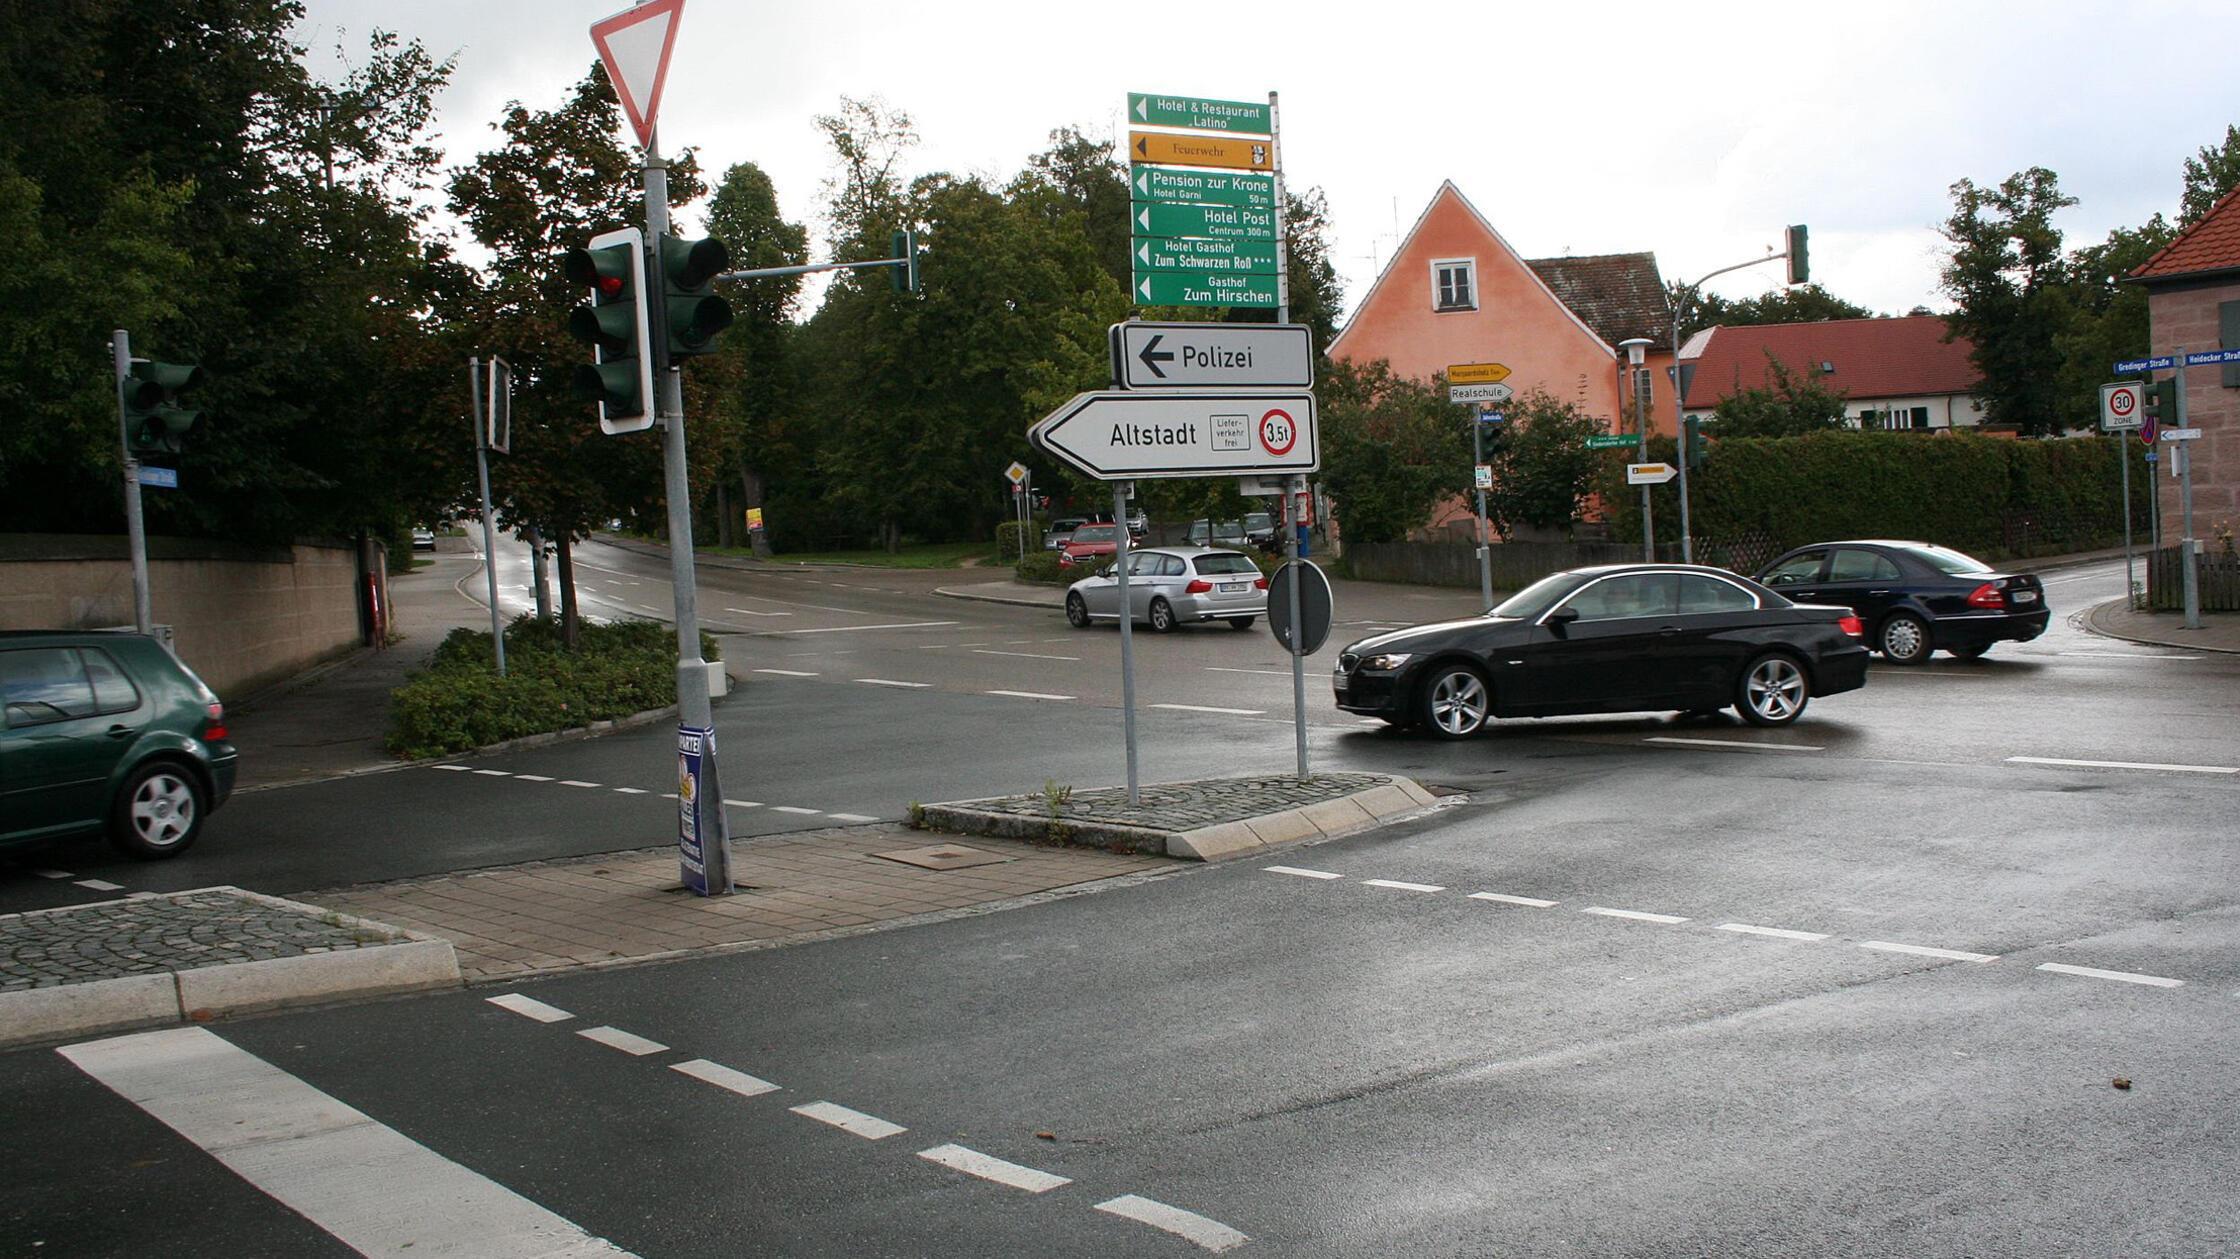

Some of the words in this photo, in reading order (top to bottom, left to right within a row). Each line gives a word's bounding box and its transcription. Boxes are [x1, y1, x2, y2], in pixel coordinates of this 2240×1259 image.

[1157, 98, 1186, 112] Hotel
[1190, 103, 1199, 113] &
[1201, 103, 1260, 119] Restaurant
[1173, 143, 1225, 157] Feuerwehr
[1152, 172, 1202, 188] Pension
[1207, 177, 1227, 188] zur
[1232, 178, 1268, 191] Krone
[1153, 188, 1176, 198] Hotel
[1205, 210, 1237, 224] Hotel
[1242, 211, 1270, 225] Post
[1208, 226, 1244, 236] Centrum
[1165, 241, 1192, 252] Hotel
[1196, 242, 1234, 253] Gasthof
[1154, 254, 1175, 267] Zum
[1179, 254, 1230, 269] Schwarzen
[1234, 257, 1251, 269] Roß
[1208, 276, 1247, 287] Gasthof
[1184, 288, 1212, 301] Zum
[1217, 289, 1272, 303] Hirschen
[1183, 345, 1253, 368] Polizei
[2149, 358, 2169, 368] Straße
[1452, 388, 1502, 398] Realschule
[2114, 395, 2130, 409] 30
[1217, 418, 1242, 428] Liefer-
[2113, 416, 2133, 425] ZONE
[1110, 423, 1197, 446] Altstadt
[1216, 428, 1244, 438] verkehr
[1266, 422, 1289, 444] 3,5t
[1224, 439, 1238, 447] frei
